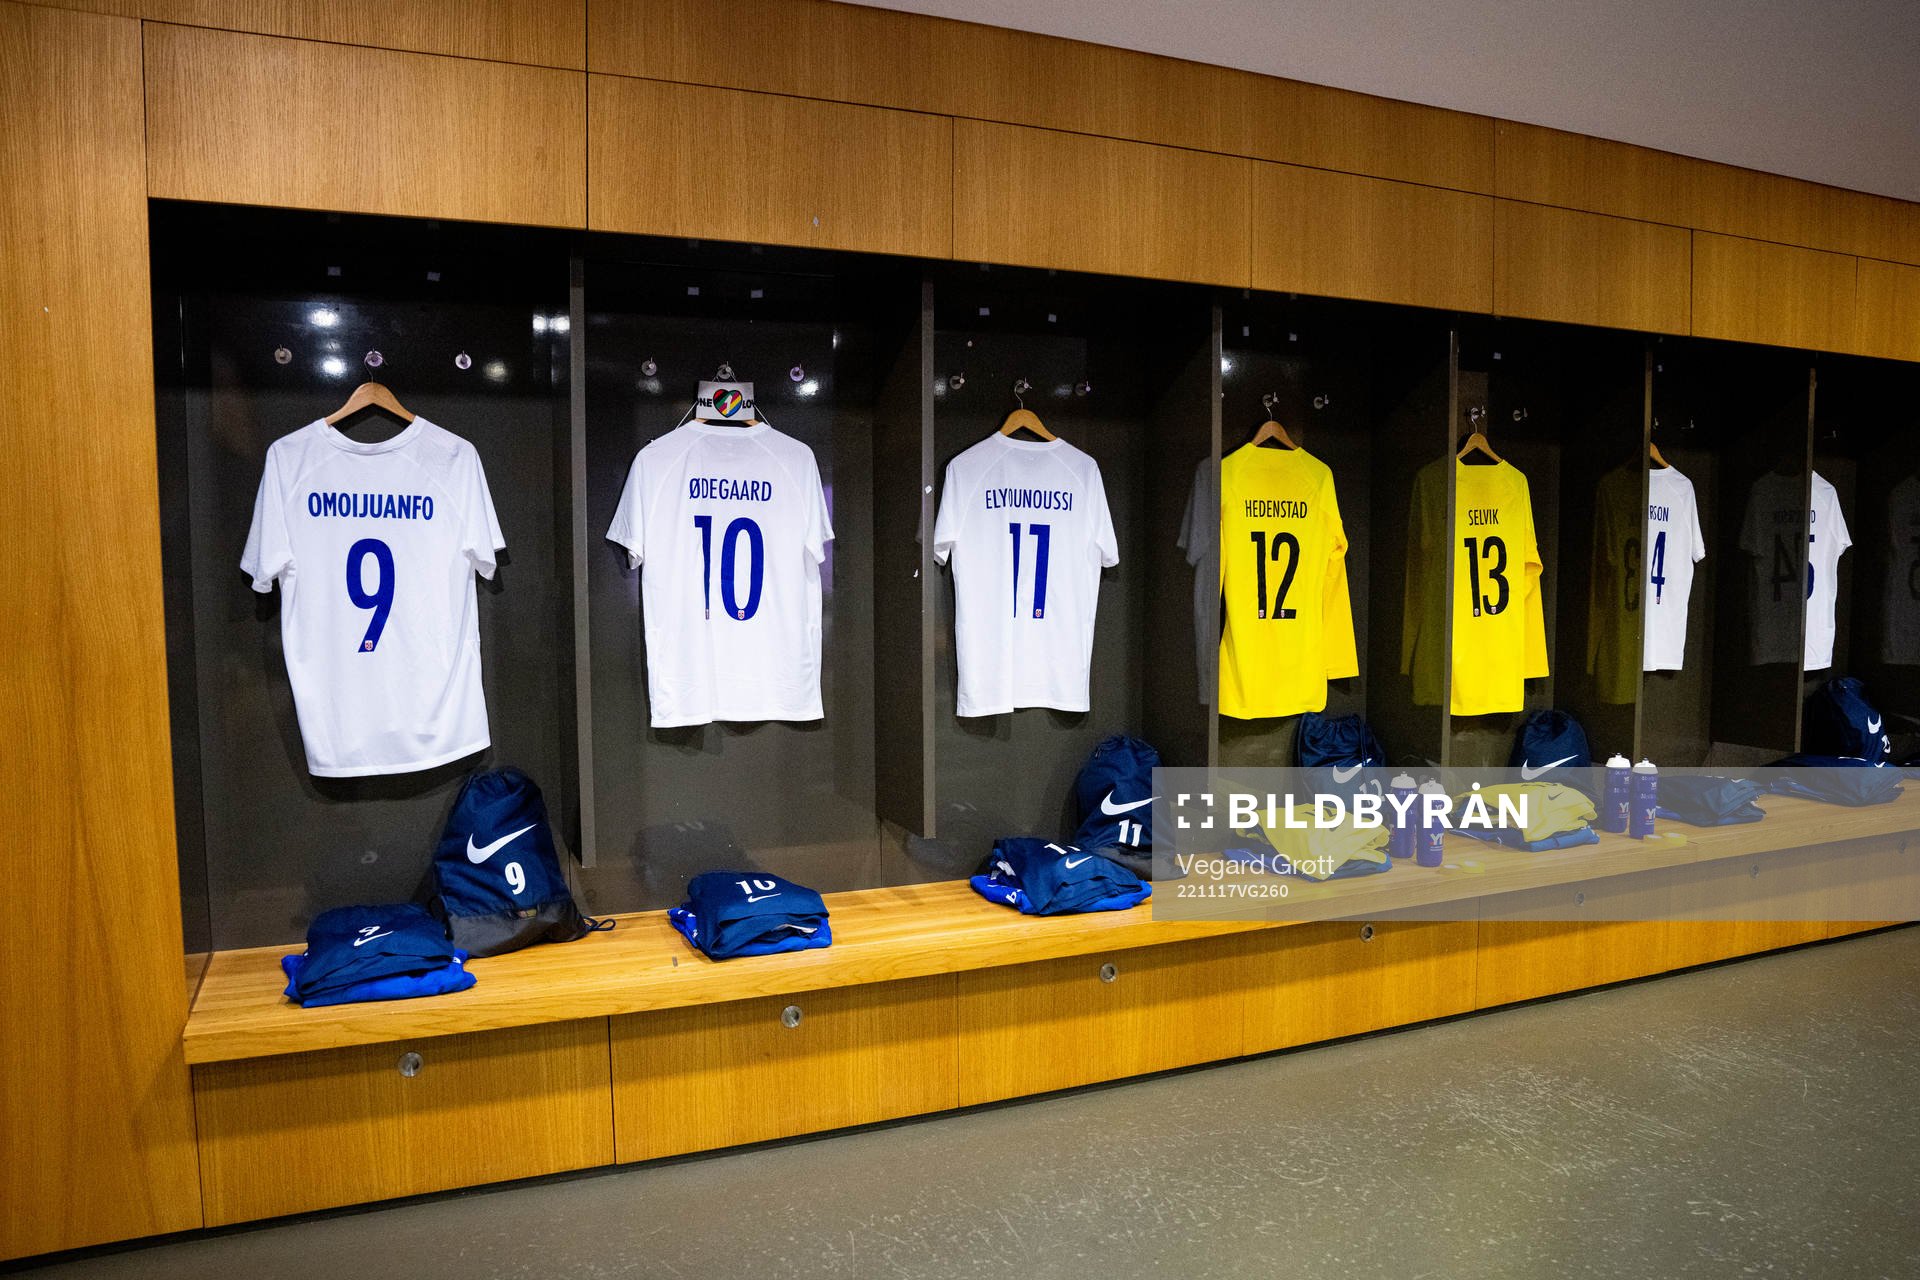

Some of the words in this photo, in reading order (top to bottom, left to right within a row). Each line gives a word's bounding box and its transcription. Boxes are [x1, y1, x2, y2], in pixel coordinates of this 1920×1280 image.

[696, 397, 713, 408] NE
[689, 477, 771, 502] ØDEGAARD
[985, 487, 1073, 512] ELYOUNOUSSI
[308, 492, 434, 521] OMOIJUANFO
[1244, 499, 1308, 519] HEDENSTAD
[1468, 508, 1499, 526] SELVIK
[1648, 505, 1669, 522] RSON
[694, 516, 764, 622] 10
[1009, 522, 1051, 619] 11
[1250, 531, 1301, 620] 12
[1463, 535, 1510, 618] 13
[345, 537, 396, 653] 9
[1118, 819, 1143, 847] 11
[504, 862, 526, 895] 9
